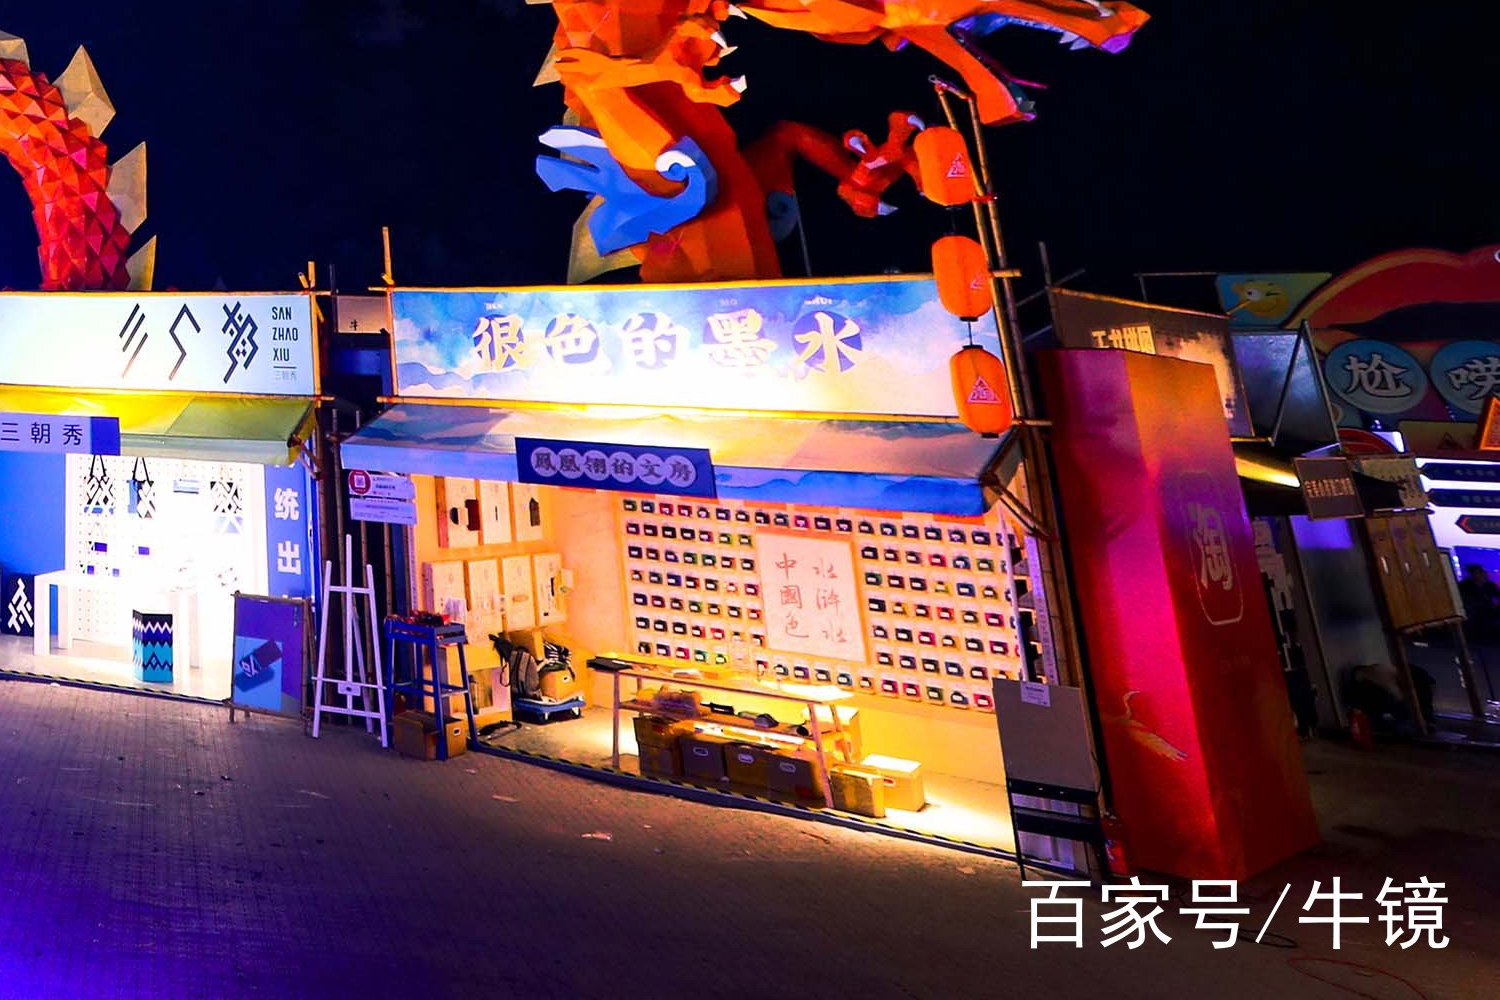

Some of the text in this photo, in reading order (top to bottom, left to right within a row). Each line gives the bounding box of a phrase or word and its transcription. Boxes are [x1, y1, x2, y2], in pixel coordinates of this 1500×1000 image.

[272, 306, 292, 321] SAN
[272, 327, 299, 342] ZHAO
[472, 308, 861, 374] 很色的墨水
[273, 348, 290, 362] XIU
[0, 421, 84, 446] 三朝秀
